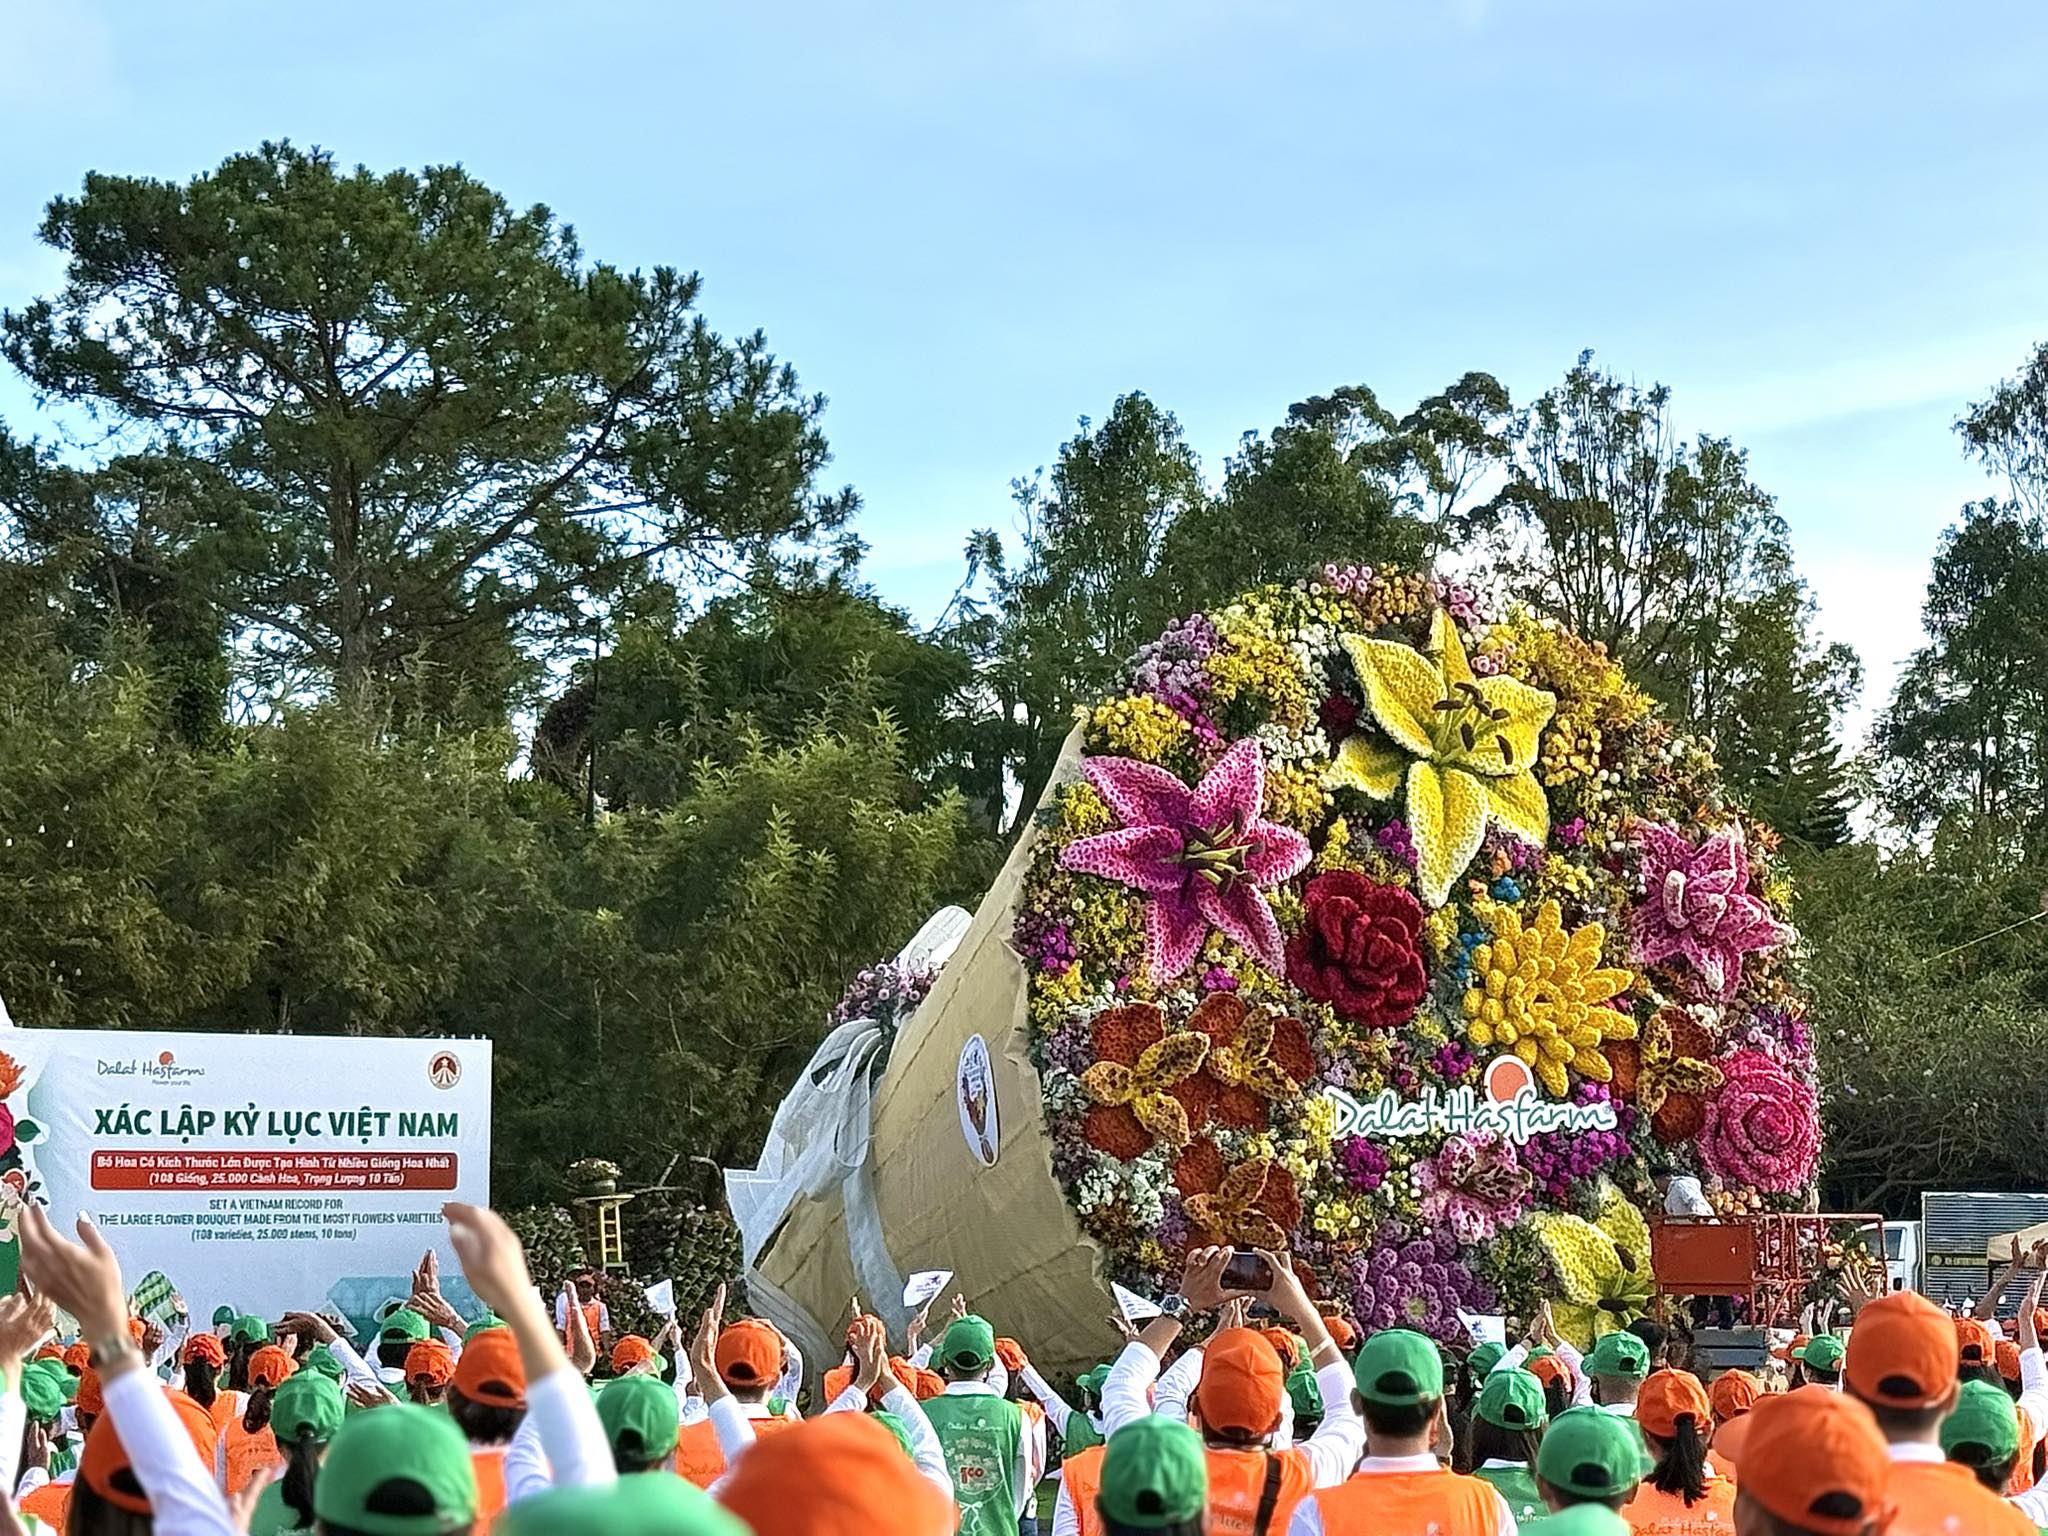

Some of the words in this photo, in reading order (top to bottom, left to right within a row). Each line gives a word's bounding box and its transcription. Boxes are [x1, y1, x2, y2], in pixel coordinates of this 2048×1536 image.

[97, 1059, 138, 1076] Dalat
[1327, 1088, 1438, 1136] Dalat
[1445, 1089, 1612, 1141] Hasfarm
[94, 1103, 152, 1135] XÁC
[160, 1104, 216, 1144] LẬP
[223, 1102, 261, 1136] KỶ
[268, 1110, 322, 1145] LỤC
[328, 1105, 391, 1145] VIỆT
[398, 1112, 458, 1137] NAM
[115, 1156, 137, 1168] Hoa
[139, 1156, 155, 1168] Có
[157, 1156, 181, 1168] Kích
[402, 1157, 423, 1169] Hoa
[149, 1172, 173, 1186] (108
[211, 1173, 248, 1184] 25.000
[368, 1173, 381, 1184] 10
[209, 1199, 227, 1210] SET
[230, 1199, 238, 1210] A
[240, 1199, 283, 1210] VIETNAM
[284, 1199, 322, 1209] RECORD
[324, 1199, 343, 1209] FOR
[99, 1214, 118, 1225] THE
[120, 1214, 153, 1225] LARGE
[155, 1214, 194, 1225] FLOWER
[196, 1214, 242, 1225] BOUQUET
[243, 1214, 272, 1225] MADE
[273, 1214, 301, 1224] FROM
[302, 1213, 321, 1223] THE
[323, 1213, 350, 1223] MOST
[352, 1213, 394, 1223] FLOWERS
[396, 1213, 443, 1223] VARIETIES
[321, 1229, 332, 1239] 10
